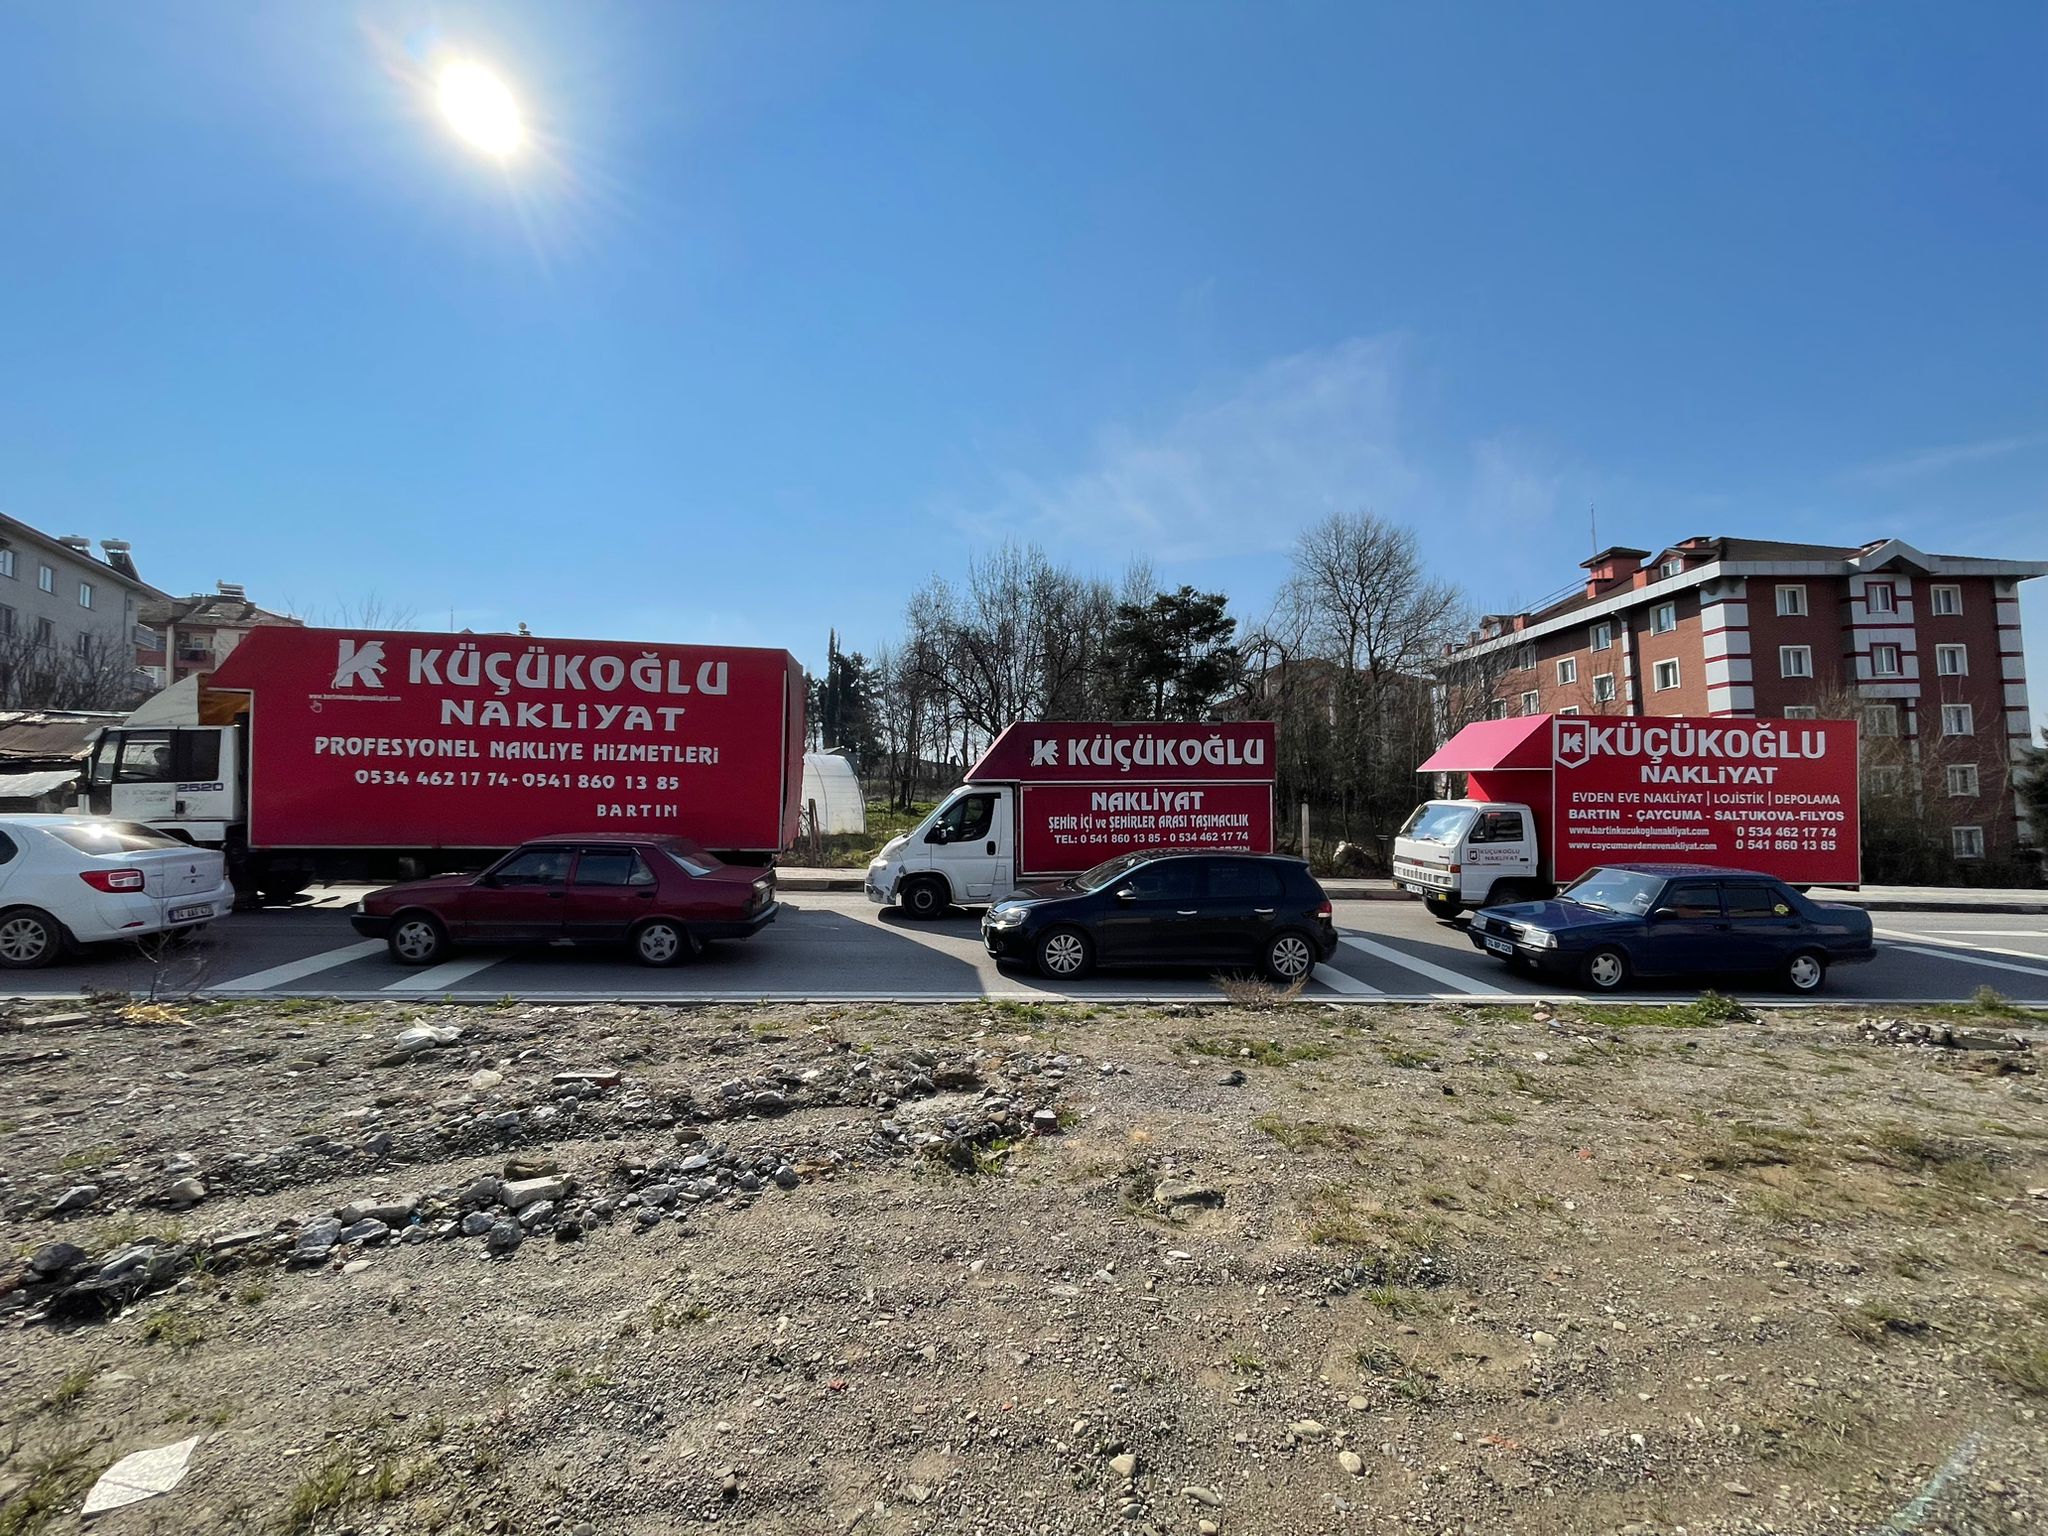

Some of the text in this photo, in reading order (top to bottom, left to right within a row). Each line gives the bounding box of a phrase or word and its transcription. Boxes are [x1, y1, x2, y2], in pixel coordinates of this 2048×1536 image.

[409, 643, 728, 696] KÜÇÜKOĞLU
[314, 736, 480, 758] PROFESYONEL
[1590, 721, 1827, 764] KÜÇÜKOĞLU
[1068, 734, 1265, 772] KÜÇÜKOĞLU
[176, 782, 224, 793] 2520
[355, 769, 410, 785] 0534
[416, 770, 455, 786] 462
[460, 771, 481, 787] 17
[577, 774, 616, 789] 860
[625, 776, 648, 790] 13
[656, 777, 679, 790] 85
[1091, 788, 1205, 813] NAKLİYAT
[1572, 792, 1615, 803] EVDEN
[1618, 792, 1640, 804] EVE
[1643, 790, 1704, 805] NAKLİYAT
[1775, 794, 1841, 806] DEPOLAMA
[597, 803, 678, 817] BARTIN
[1568, 809, 1621, 820] BARTIN
[1636, 810, 1702, 823] ÇAYCUMA
[1048, 813, 1250, 833] ŞEHİR İÇİ ve ŞEHİRLER ARASI TAŞIMACILIK
[1054, 835, 1078, 844] TEL:
[1080, 835, 1087, 844] 0
[1090, 835, 1108, 844] 541
[1111, 835, 1130, 844] 860
[1133, 835, 1146, 844] 13
[1148, 834, 1161, 844] 85
[1169, 834, 1176, 843] 0
[1178, 833, 1198, 842] 534
[1200, 832, 1219, 841] 462
[1221, 832, 1234, 841] 17
[1236, 832, 1249, 841] 74
[1736, 827, 1836, 838] 0 534 462 17 74
[1735, 839, 1836, 850] 0 541 860 13 85
